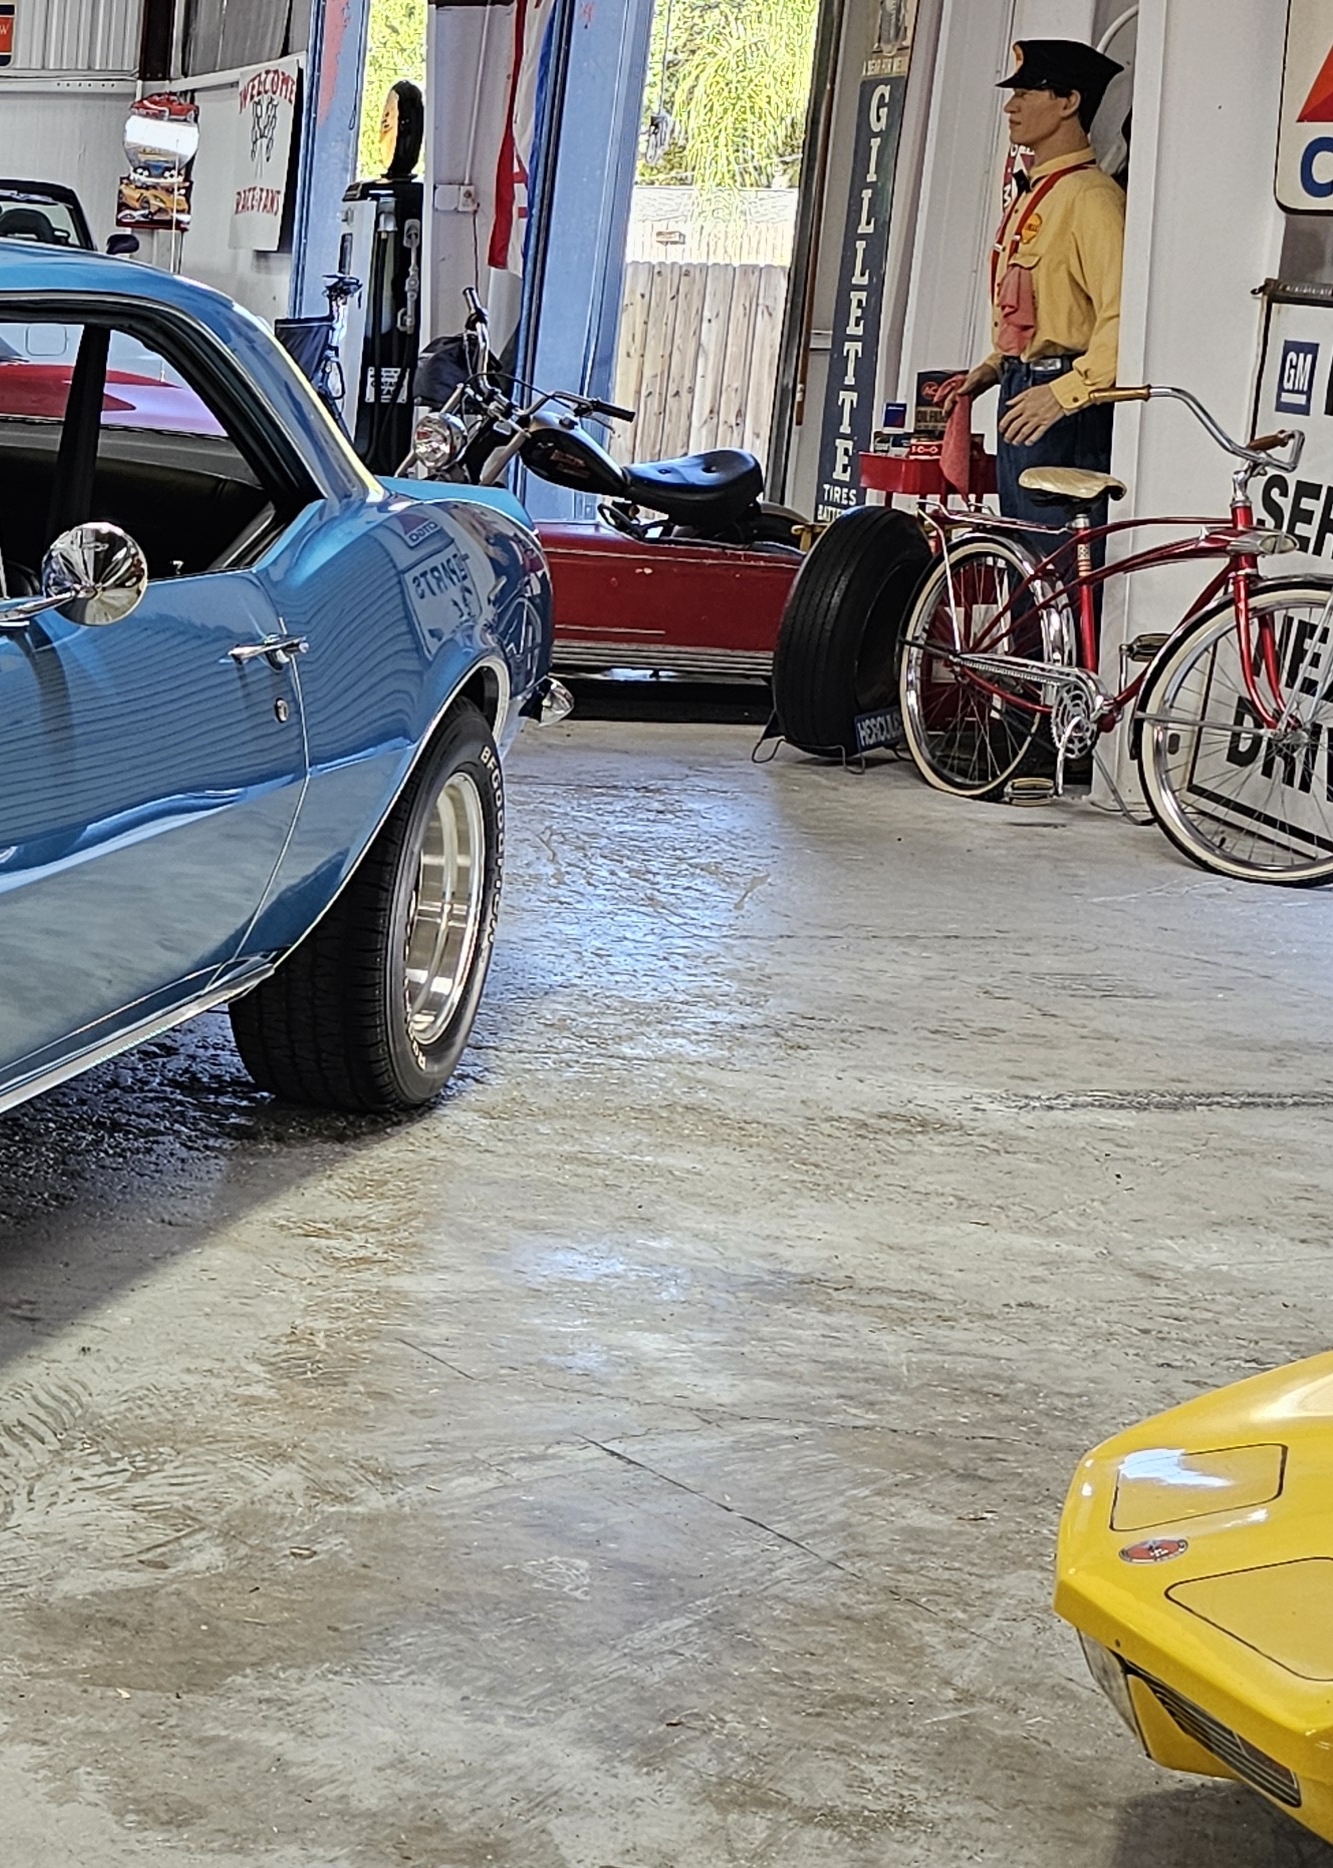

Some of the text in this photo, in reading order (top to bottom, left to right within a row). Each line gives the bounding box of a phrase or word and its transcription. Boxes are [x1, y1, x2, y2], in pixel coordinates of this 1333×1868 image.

[238, 67, 297, 114] WELCOME
[833, 84, 891, 482] GILLETTE
[1284, 351, 1313, 394] GM
[823, 484, 857, 506] TIRES
